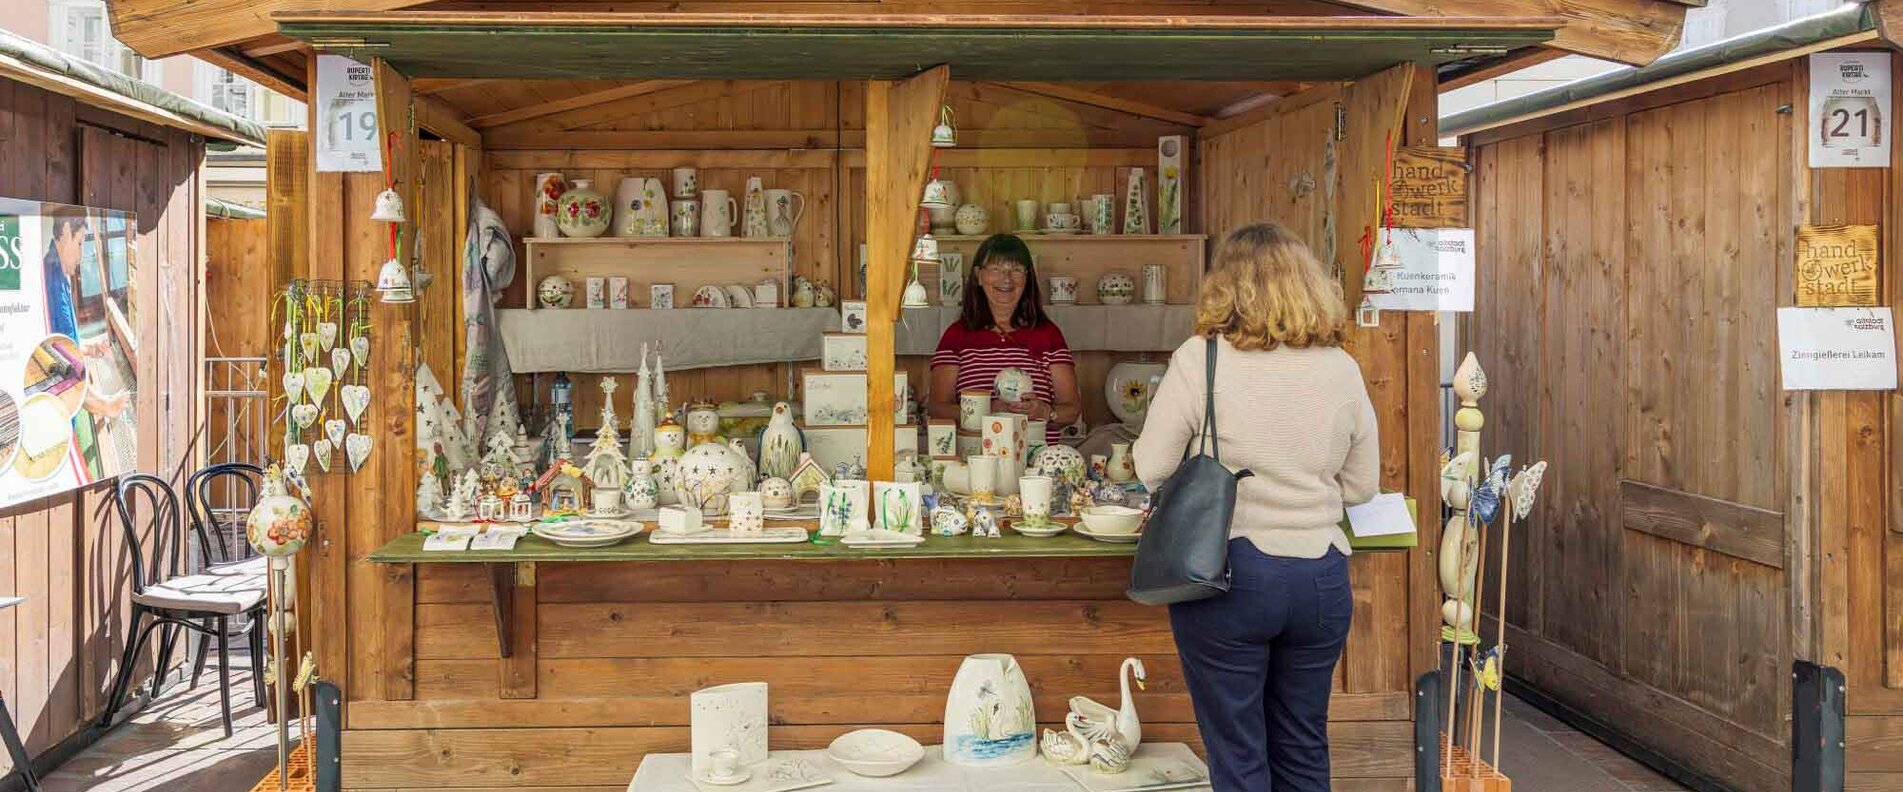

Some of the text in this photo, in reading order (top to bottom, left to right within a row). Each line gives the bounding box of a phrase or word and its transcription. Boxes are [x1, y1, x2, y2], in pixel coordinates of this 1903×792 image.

[339, 111, 377, 141] 19
[1830, 108, 1868, 137] 21
[1393, 161, 1445, 180] hand
[1392, 200, 1443, 217] stadt
[1805, 239, 1858, 259] hand
[1823, 254, 1873, 278] werk
[1805, 277, 1858, 296] stadt
[1792, 350, 1886, 361] Zinngießerei Leikam
